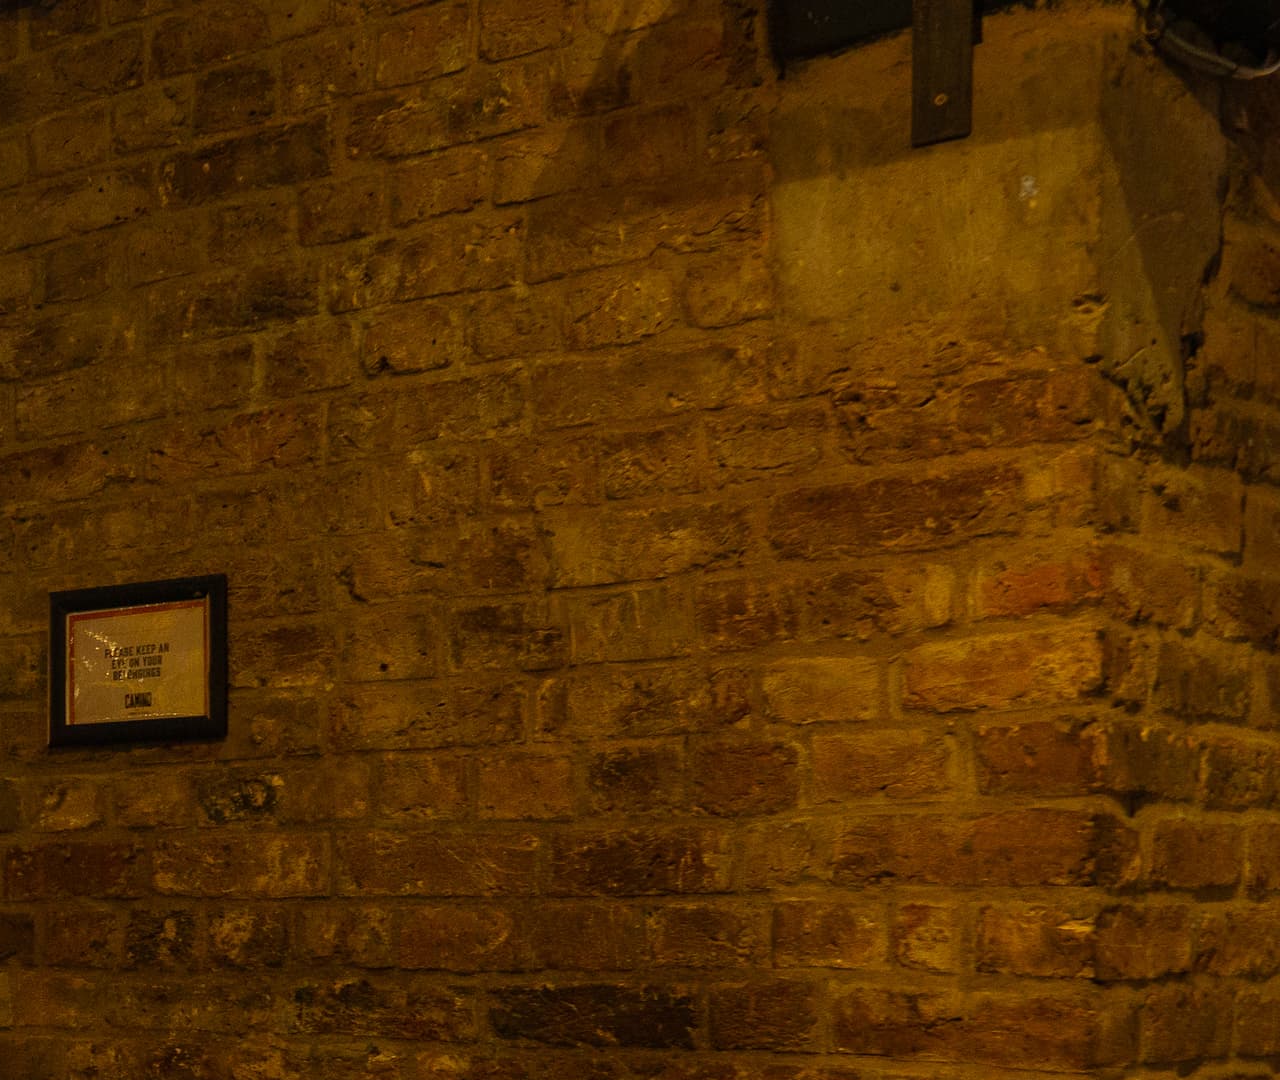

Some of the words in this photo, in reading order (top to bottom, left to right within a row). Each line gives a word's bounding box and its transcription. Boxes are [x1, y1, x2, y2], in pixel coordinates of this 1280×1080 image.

[136, 644, 156, 656] KEEP
[158, 642, 170, 653] AN
[143, 655, 162, 666] YOUR
